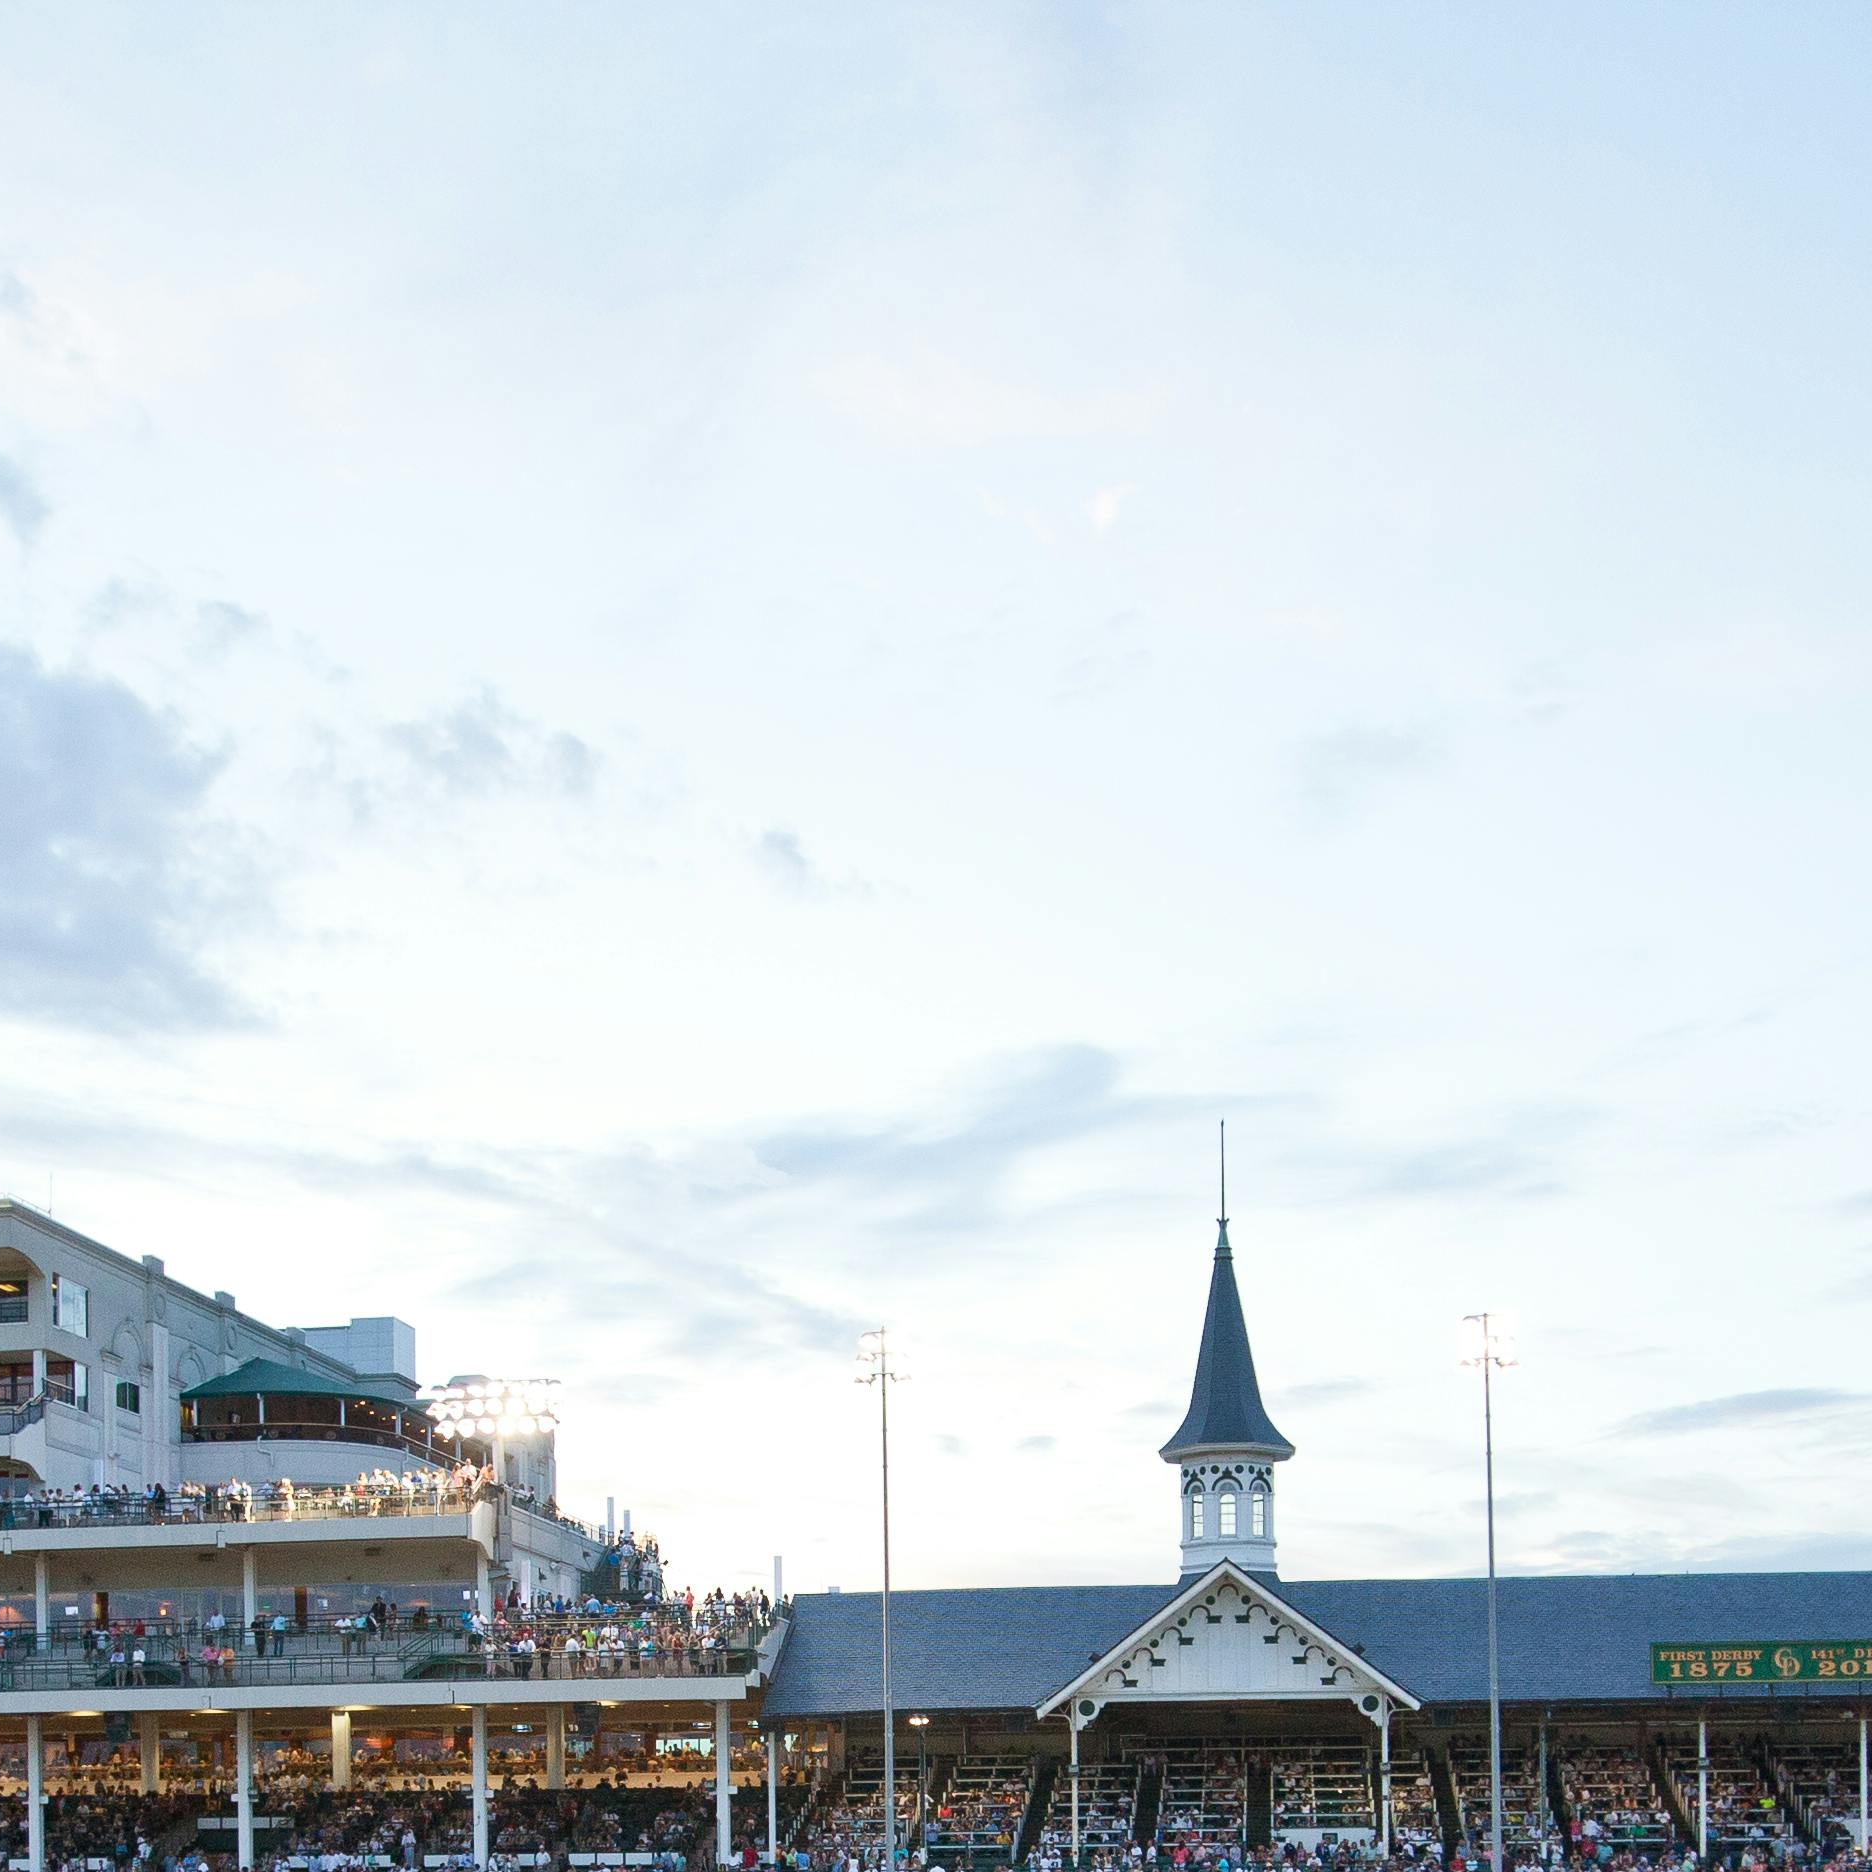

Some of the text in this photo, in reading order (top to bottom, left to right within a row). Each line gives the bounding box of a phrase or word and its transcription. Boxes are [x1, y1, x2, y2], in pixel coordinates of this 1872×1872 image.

[1659, 1649, 1762, 1661] FIRST DERBY
[1670, 1661, 1753, 1677] 1875
